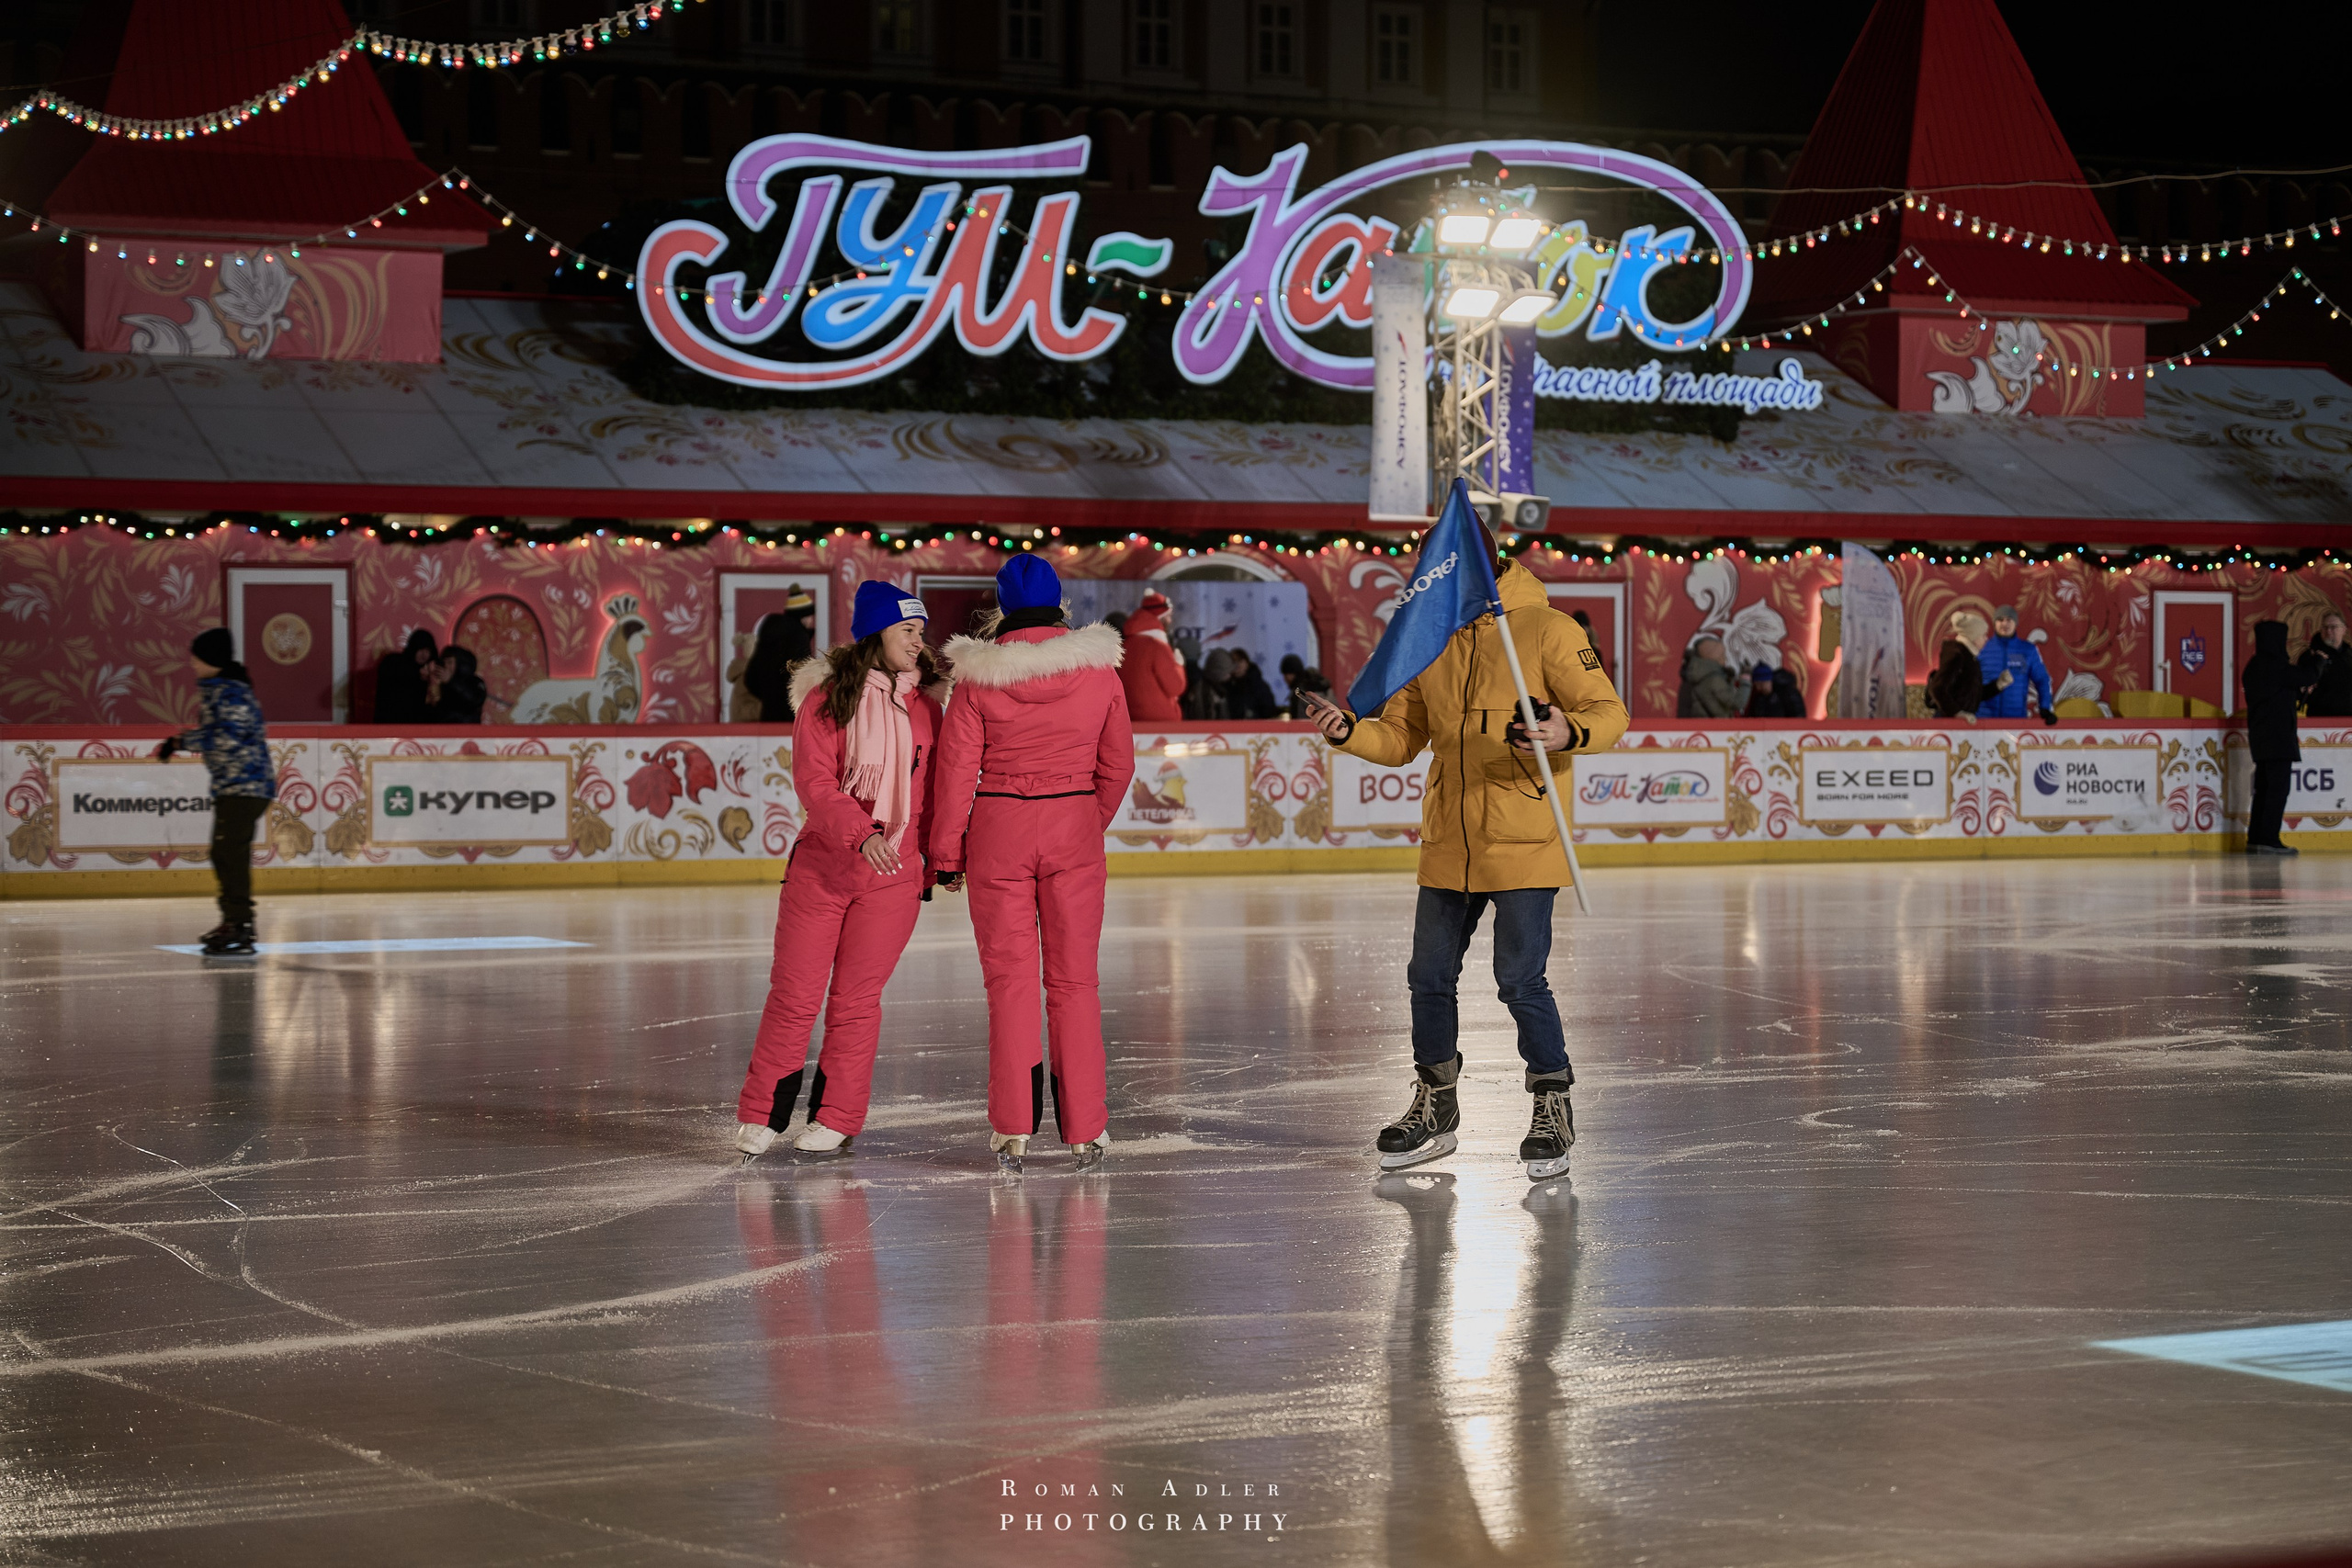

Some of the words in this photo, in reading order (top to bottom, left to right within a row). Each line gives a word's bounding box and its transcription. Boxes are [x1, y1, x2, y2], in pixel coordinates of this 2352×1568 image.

[1533, 353, 1661, 403] расной
[1663, 357, 1824, 412] площади
[1396, 359, 1408, 470] АЭРОФЛОТ
[1498, 364, 1513, 473] АЭРОФЛОТ
[1817, 770, 1934, 787] EXEED
[2066, 762, 2098, 776] РИА
[1360, 773, 1427, 804] BOS
[2066, 780, 2145, 794] НОВОСТИ
[419, 790, 556, 814] купер
